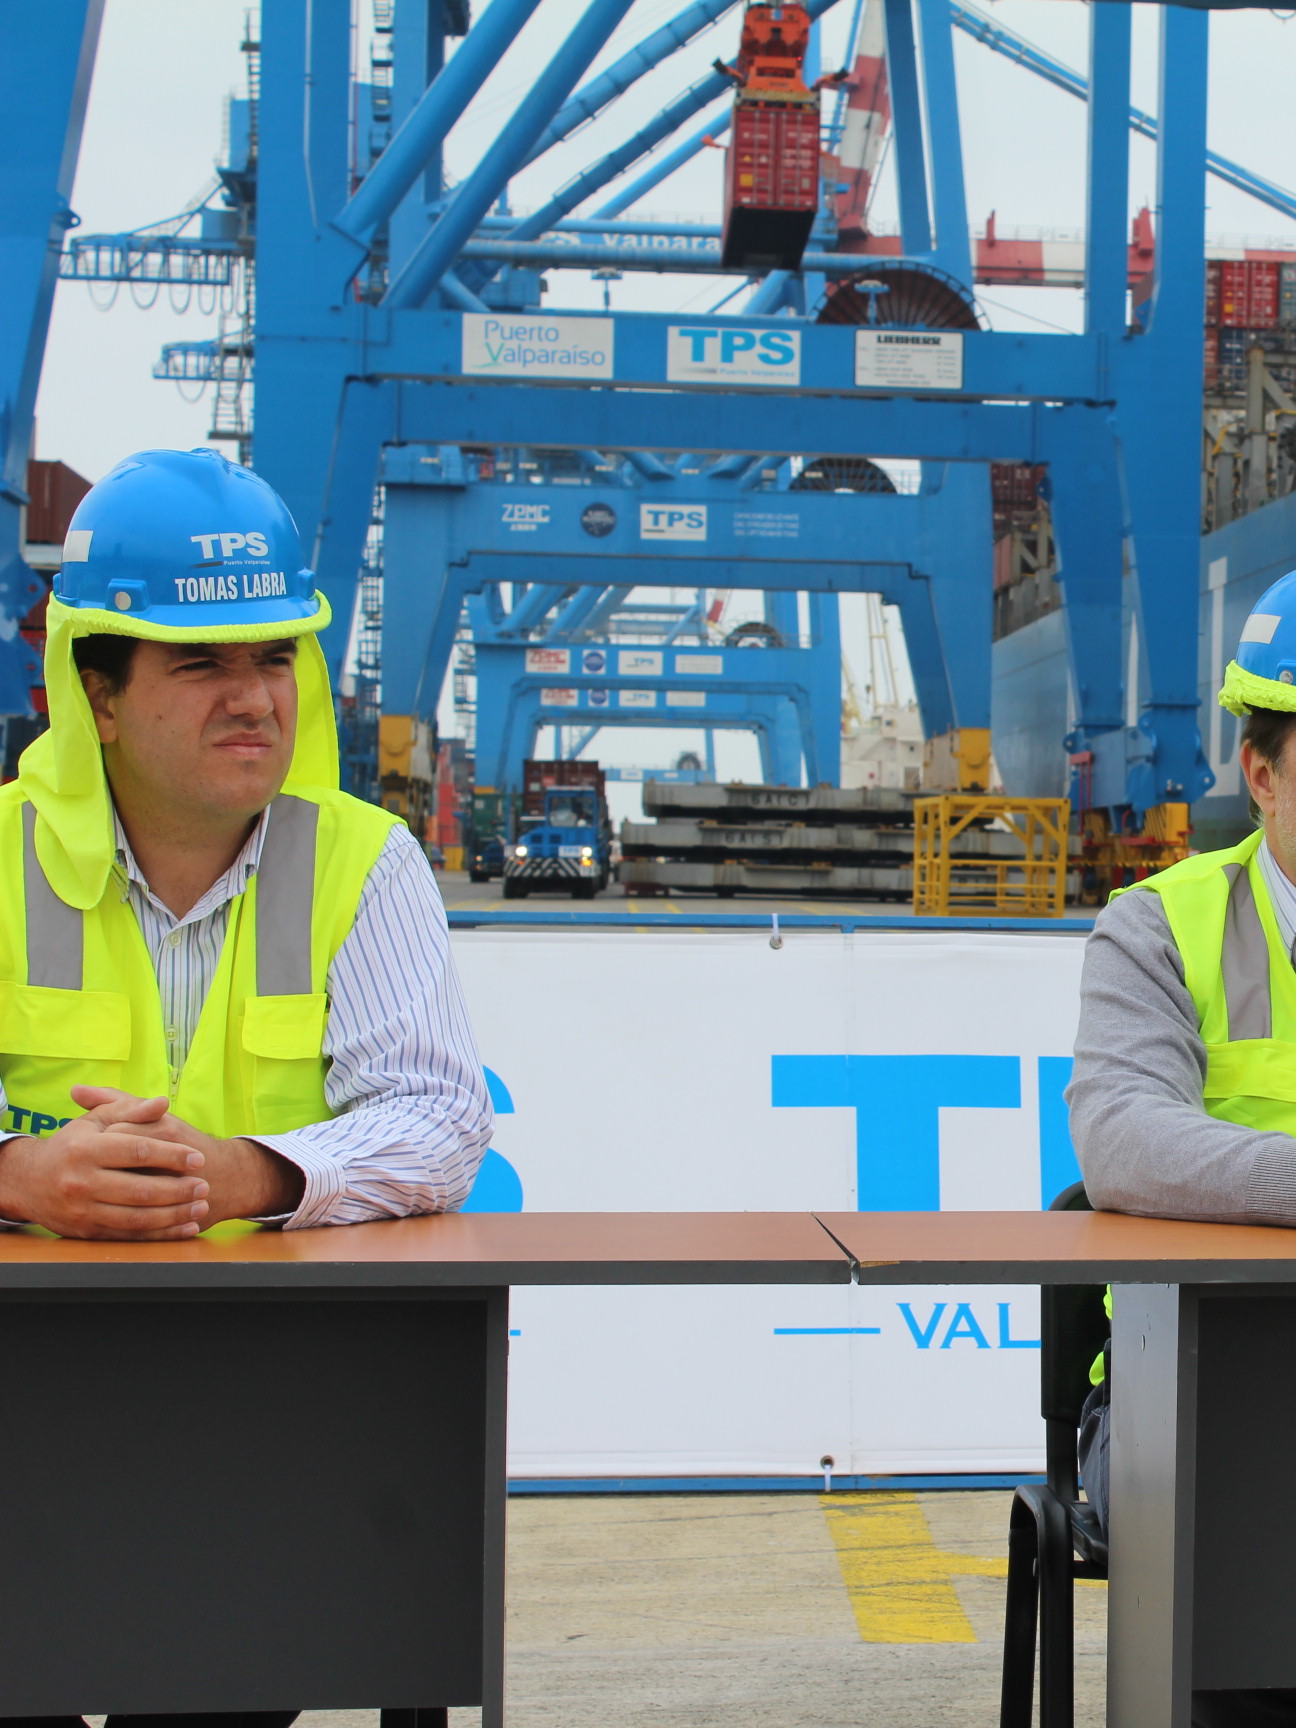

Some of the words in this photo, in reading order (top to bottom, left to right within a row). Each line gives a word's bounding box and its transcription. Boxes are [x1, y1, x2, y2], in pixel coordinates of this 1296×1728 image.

[484, 319, 560, 342] Puerto
[484, 342, 606, 368] Valparaíso
[678, 328, 796, 366] TPS
[501, 504, 550, 523] ZPMC
[646, 510, 705, 529] TPS
[190, 531, 269, 559] TPS
[174, 575, 239, 603] TOMAS
[242, 571, 288, 599] LABRA
